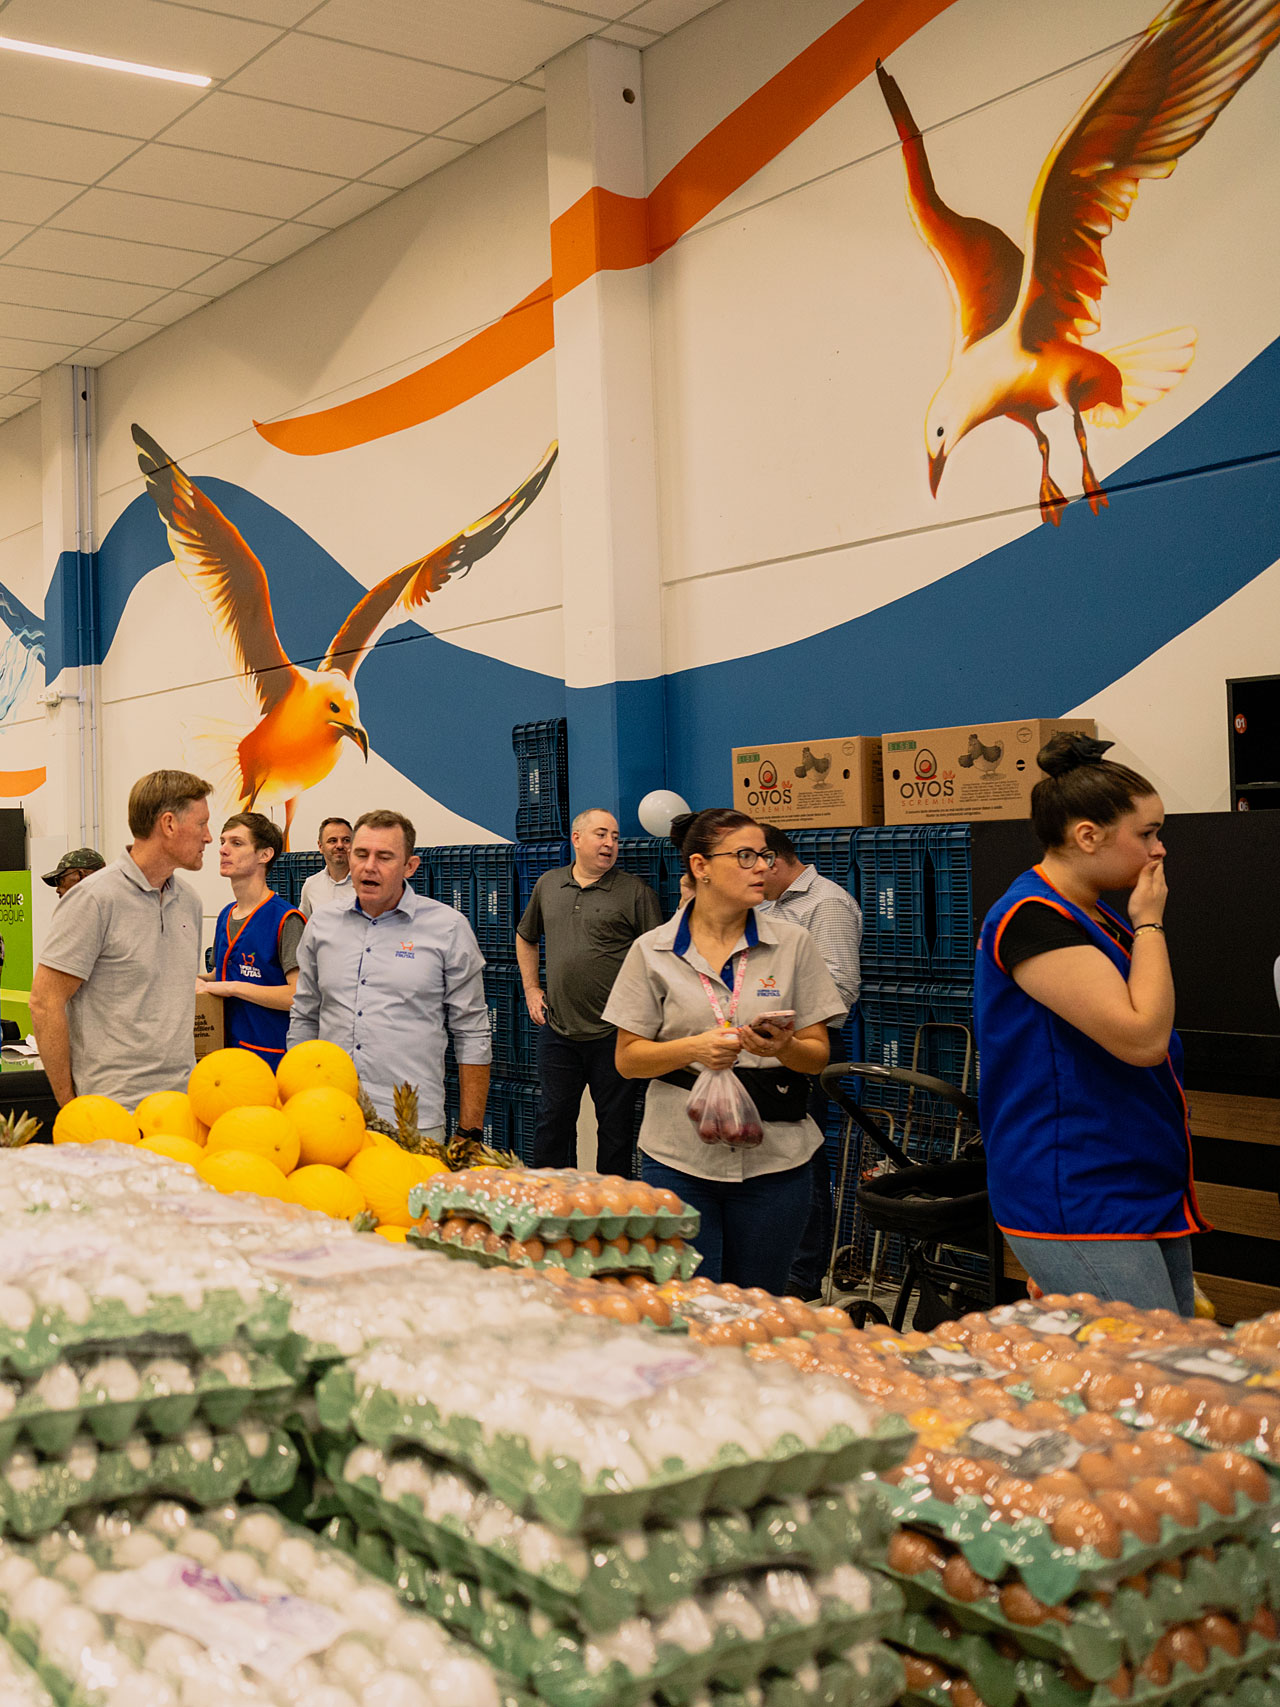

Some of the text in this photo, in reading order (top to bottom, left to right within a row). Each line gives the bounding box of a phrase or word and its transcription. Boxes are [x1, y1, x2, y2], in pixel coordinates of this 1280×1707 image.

[1235, 718, 1245, 728] 01
[900, 779, 954, 798] OVOS
[747, 789, 792, 806] OVOS
[901, 798, 954, 807] SCREMIN
[748, 806, 792, 814] SCREMIN
